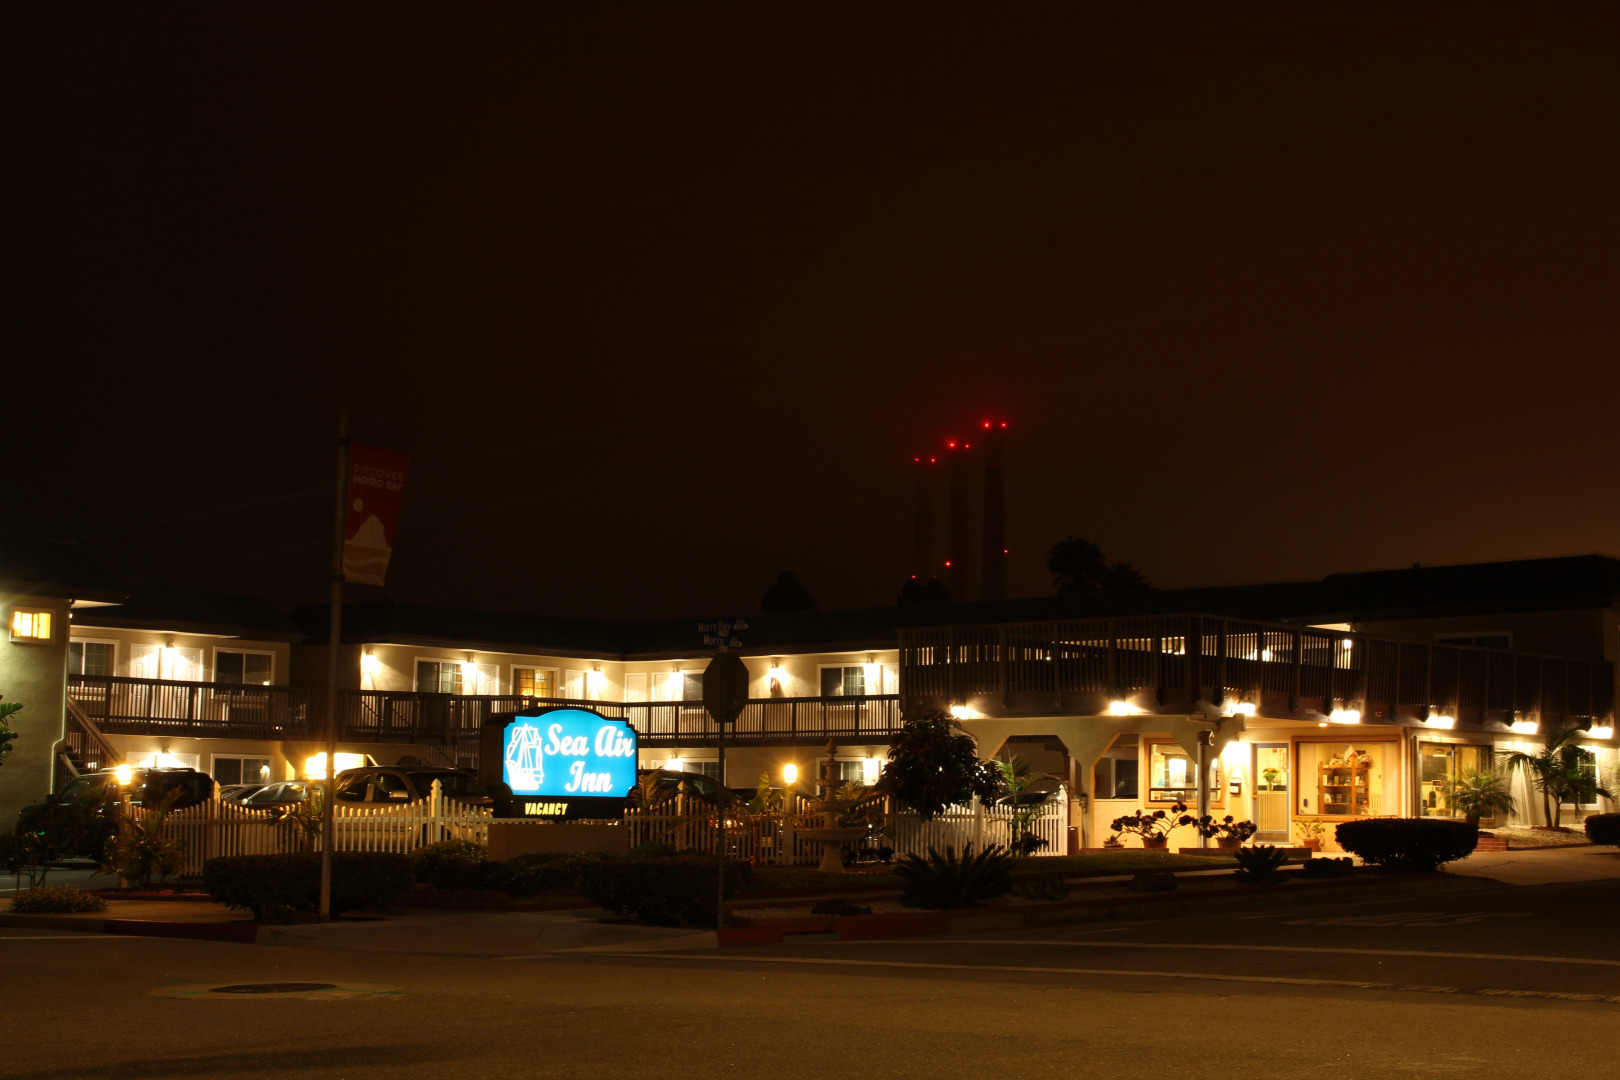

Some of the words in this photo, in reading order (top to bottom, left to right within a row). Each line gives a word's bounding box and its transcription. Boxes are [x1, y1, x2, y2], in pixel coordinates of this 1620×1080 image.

[354, 464, 403, 480] DISCOVER
[353, 474, 384, 488] MORRO
[386, 481, 402, 491] BAY
[698, 622, 717, 632] Morro
[718, 621, 731, 634] Bay
[704, 634, 724, 646] Morro
[544, 723, 589, 756] Sea
[594, 725, 635, 757] Air
[565, 760, 613, 792] Inn
[524, 802, 568, 815] VACANCY
